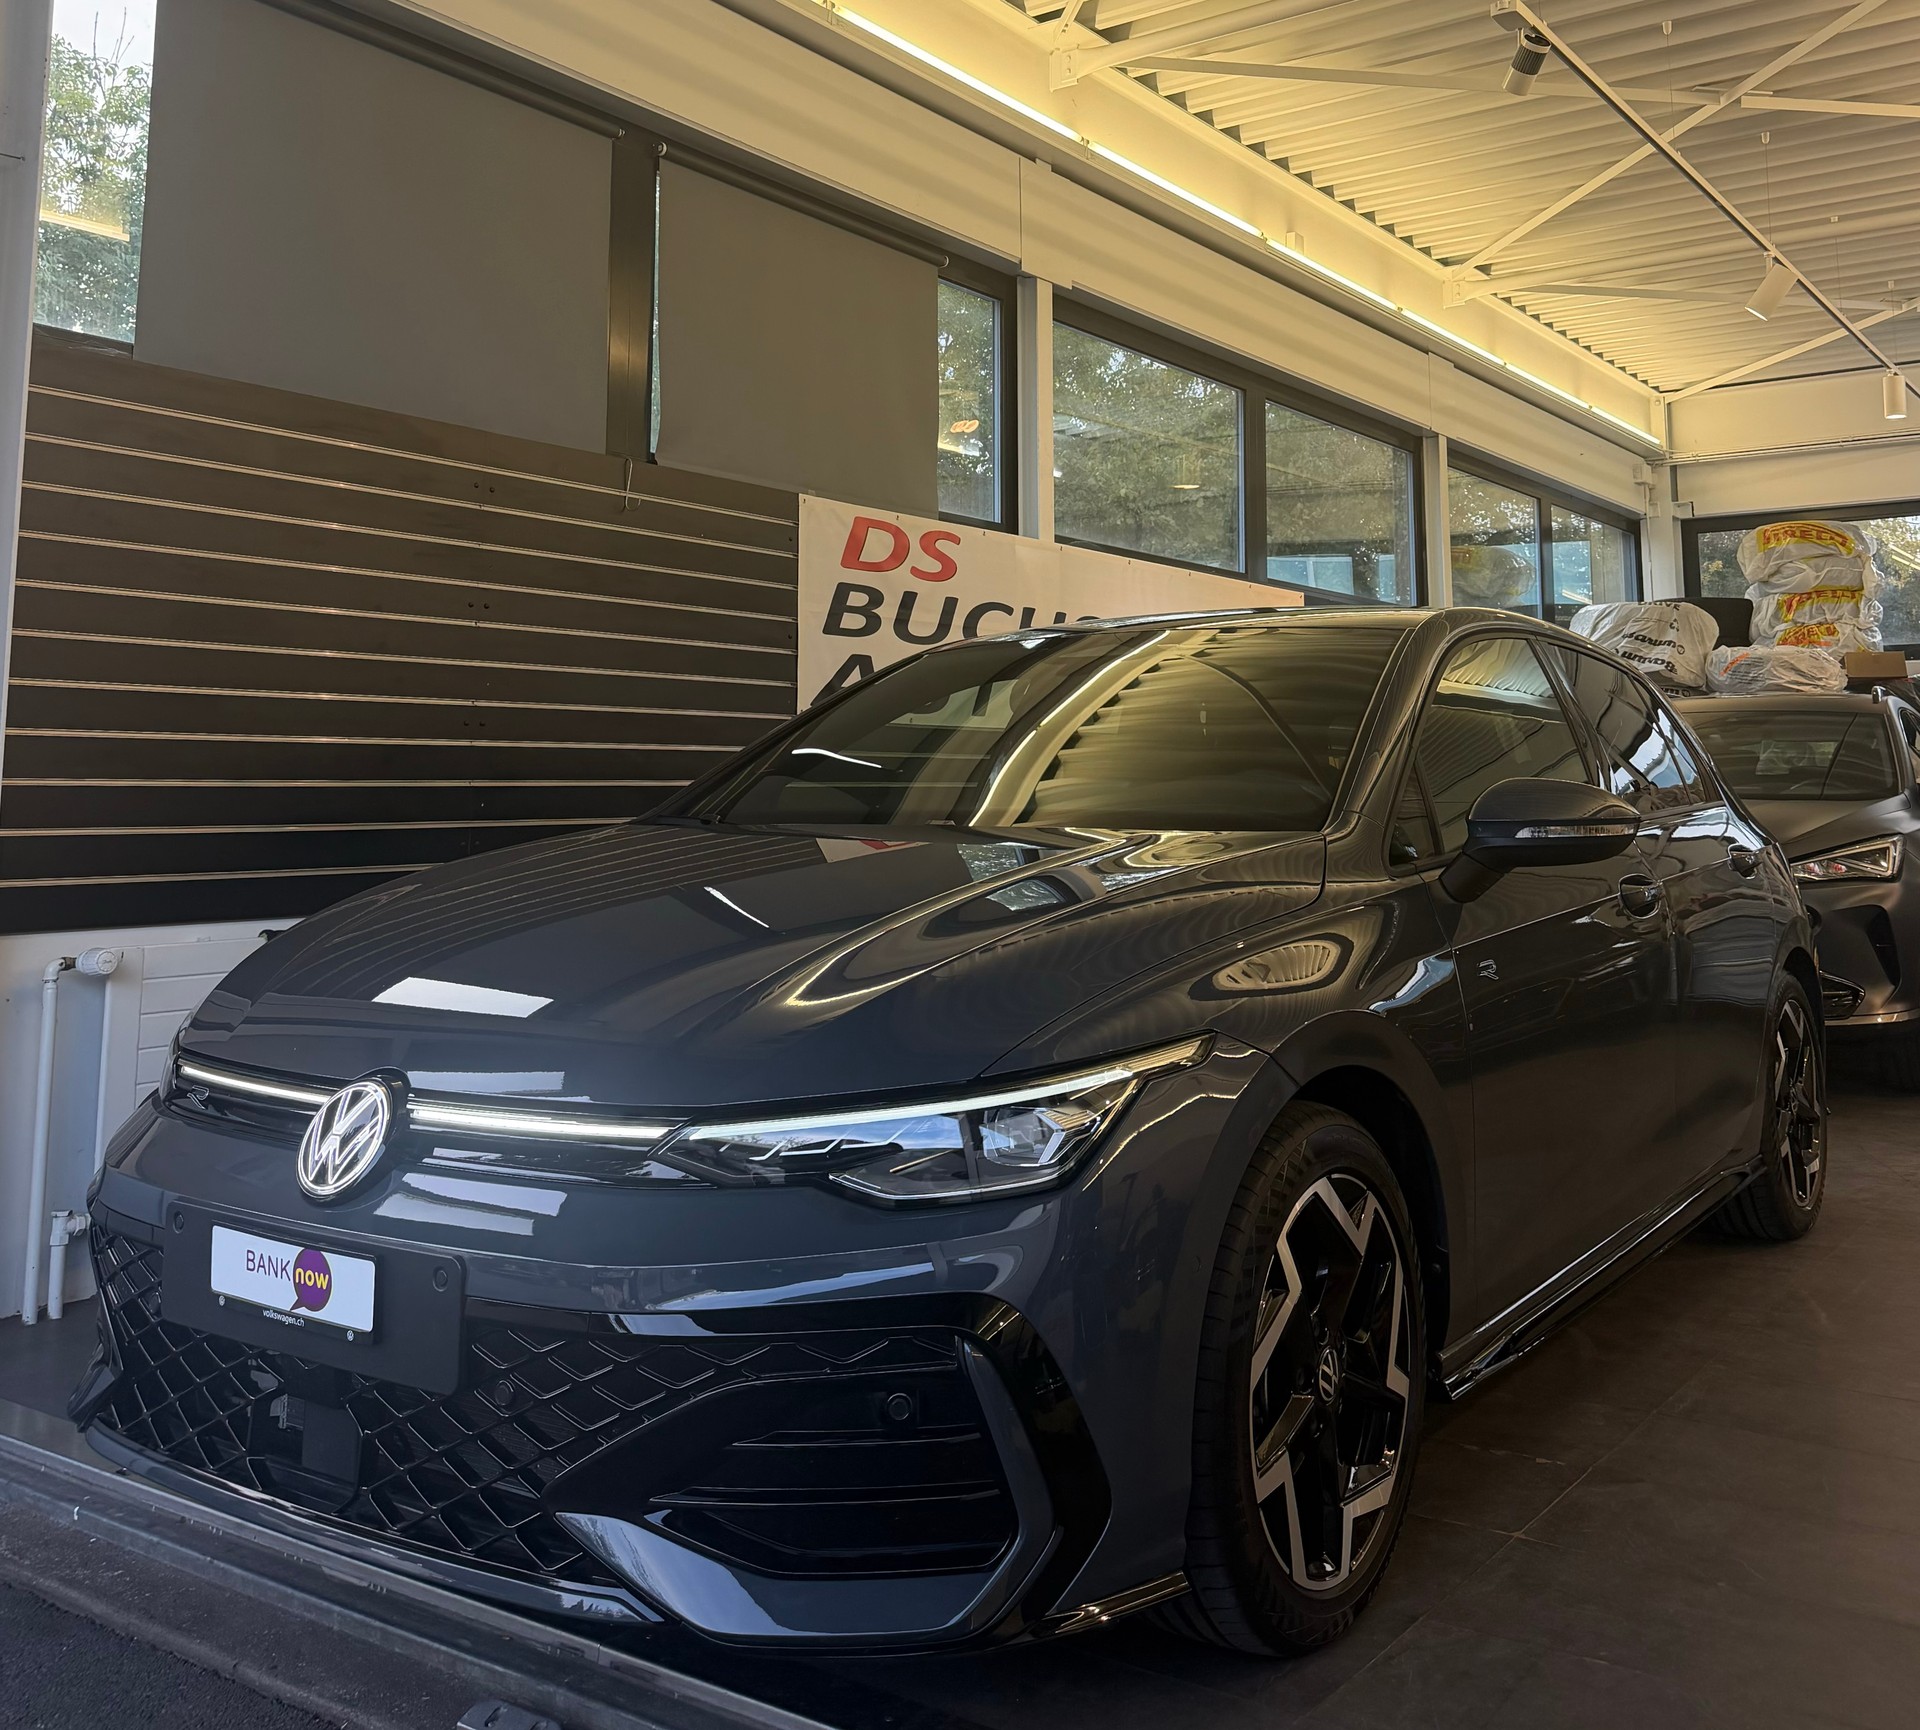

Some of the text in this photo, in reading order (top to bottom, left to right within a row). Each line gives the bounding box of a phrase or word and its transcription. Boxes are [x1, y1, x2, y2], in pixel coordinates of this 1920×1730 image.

[840, 516, 961, 582] DS
[822, 582, 1100, 645] BUC
[246, 1250, 329, 1290] BANK now
[262, 1309, 305, 1327] volkswagen.ch
